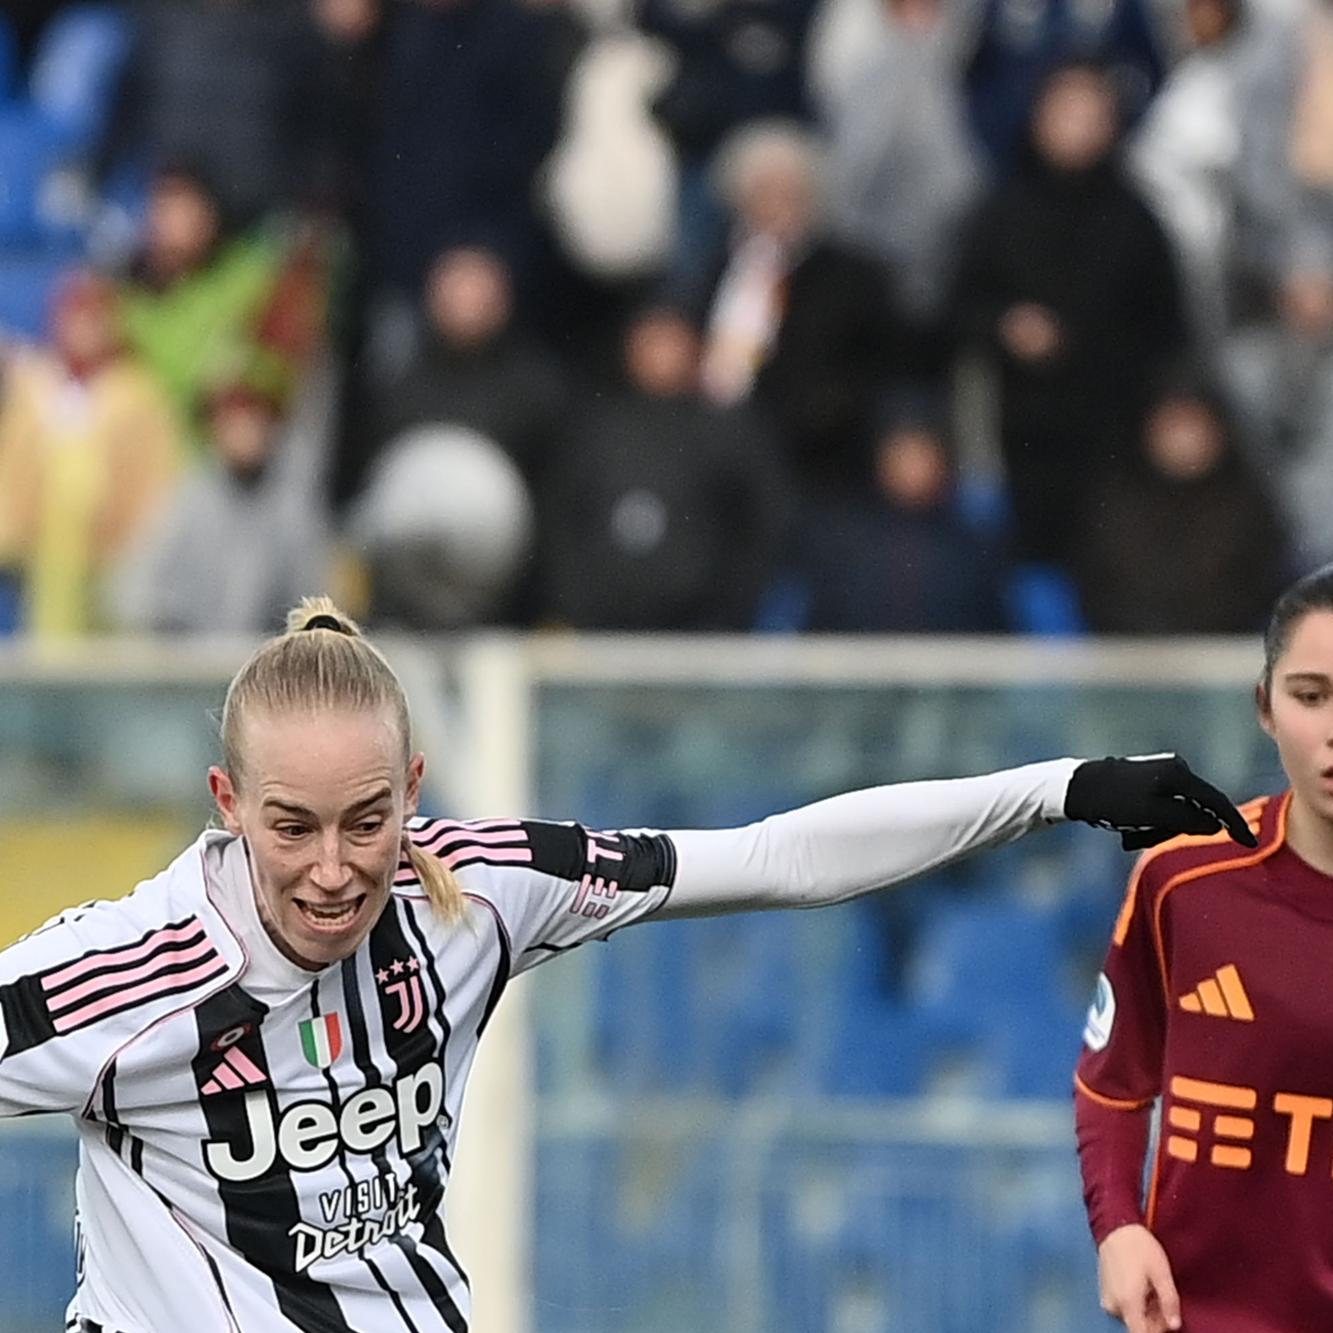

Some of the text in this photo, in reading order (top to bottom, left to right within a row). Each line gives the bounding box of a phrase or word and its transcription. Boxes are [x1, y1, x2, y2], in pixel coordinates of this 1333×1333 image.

[206, 1061, 443, 1181] Jeep
[288, 1183, 422, 1272] Detroit
[319, 1172, 396, 1222] VISIT
